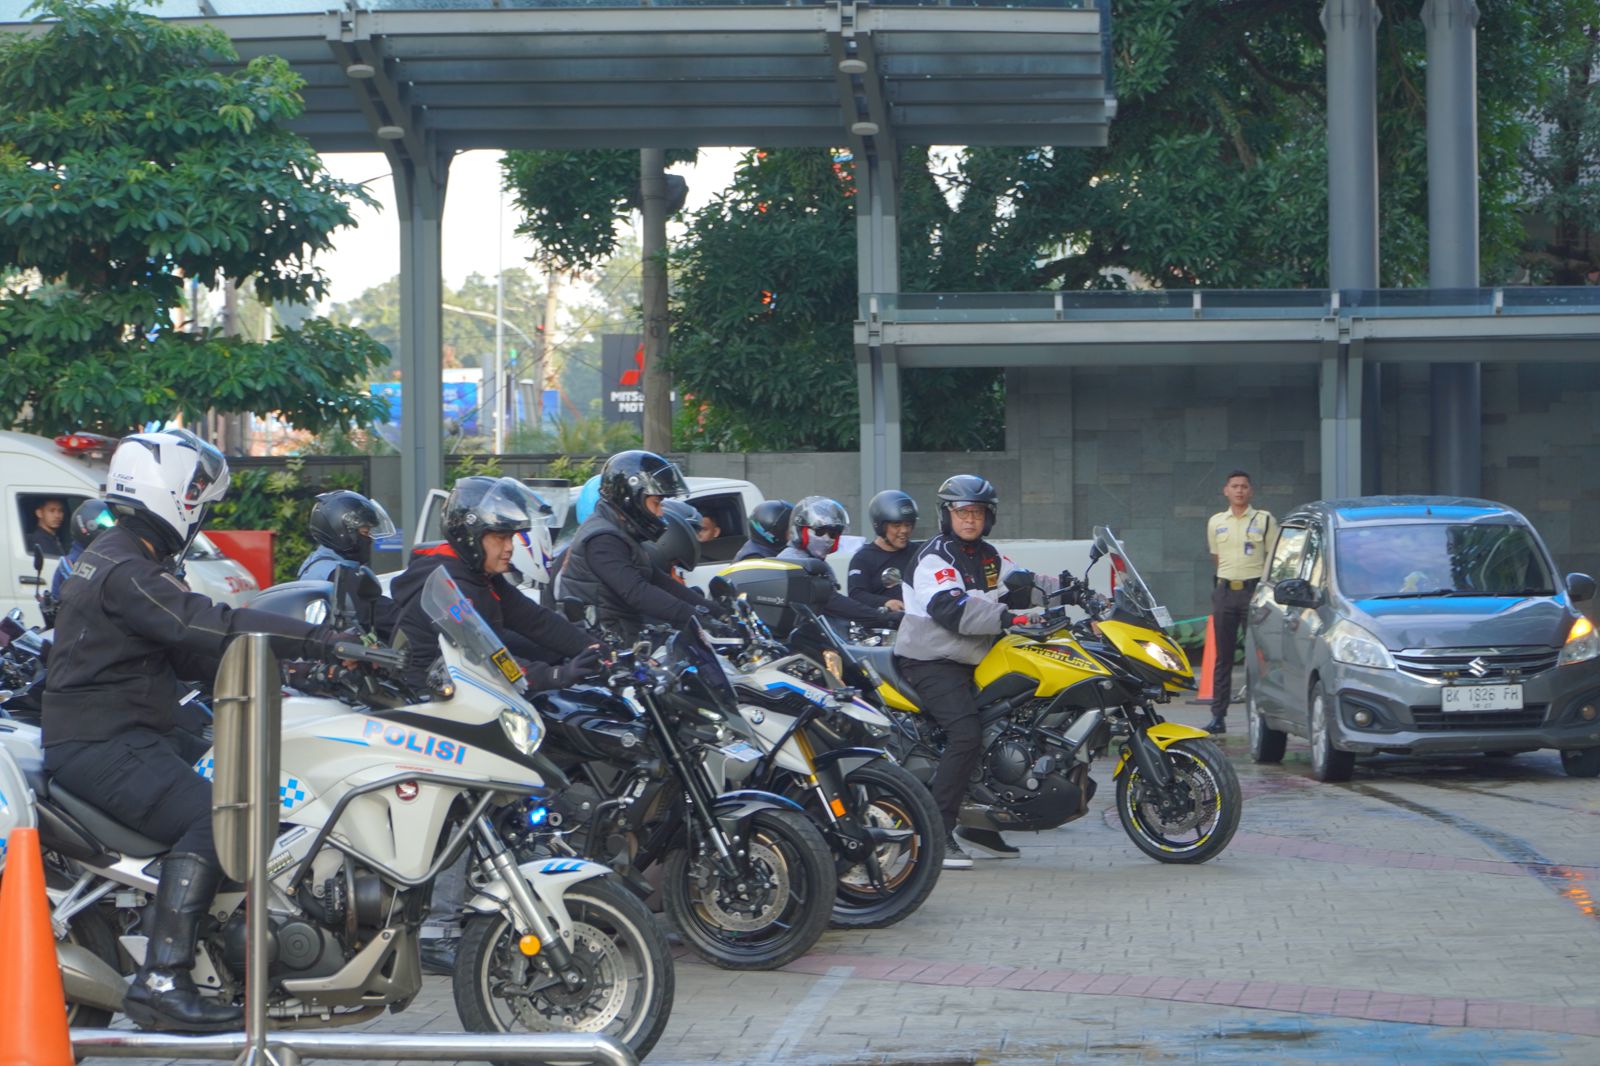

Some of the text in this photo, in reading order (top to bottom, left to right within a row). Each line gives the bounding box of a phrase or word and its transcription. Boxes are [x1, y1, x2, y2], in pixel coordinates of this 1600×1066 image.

[610, 391, 676, 402] MITSI
[618, 402, 644, 413] MOT
[1021, 644, 1094, 670] ADVENTURE
[363, 718, 468, 766] POLISI
